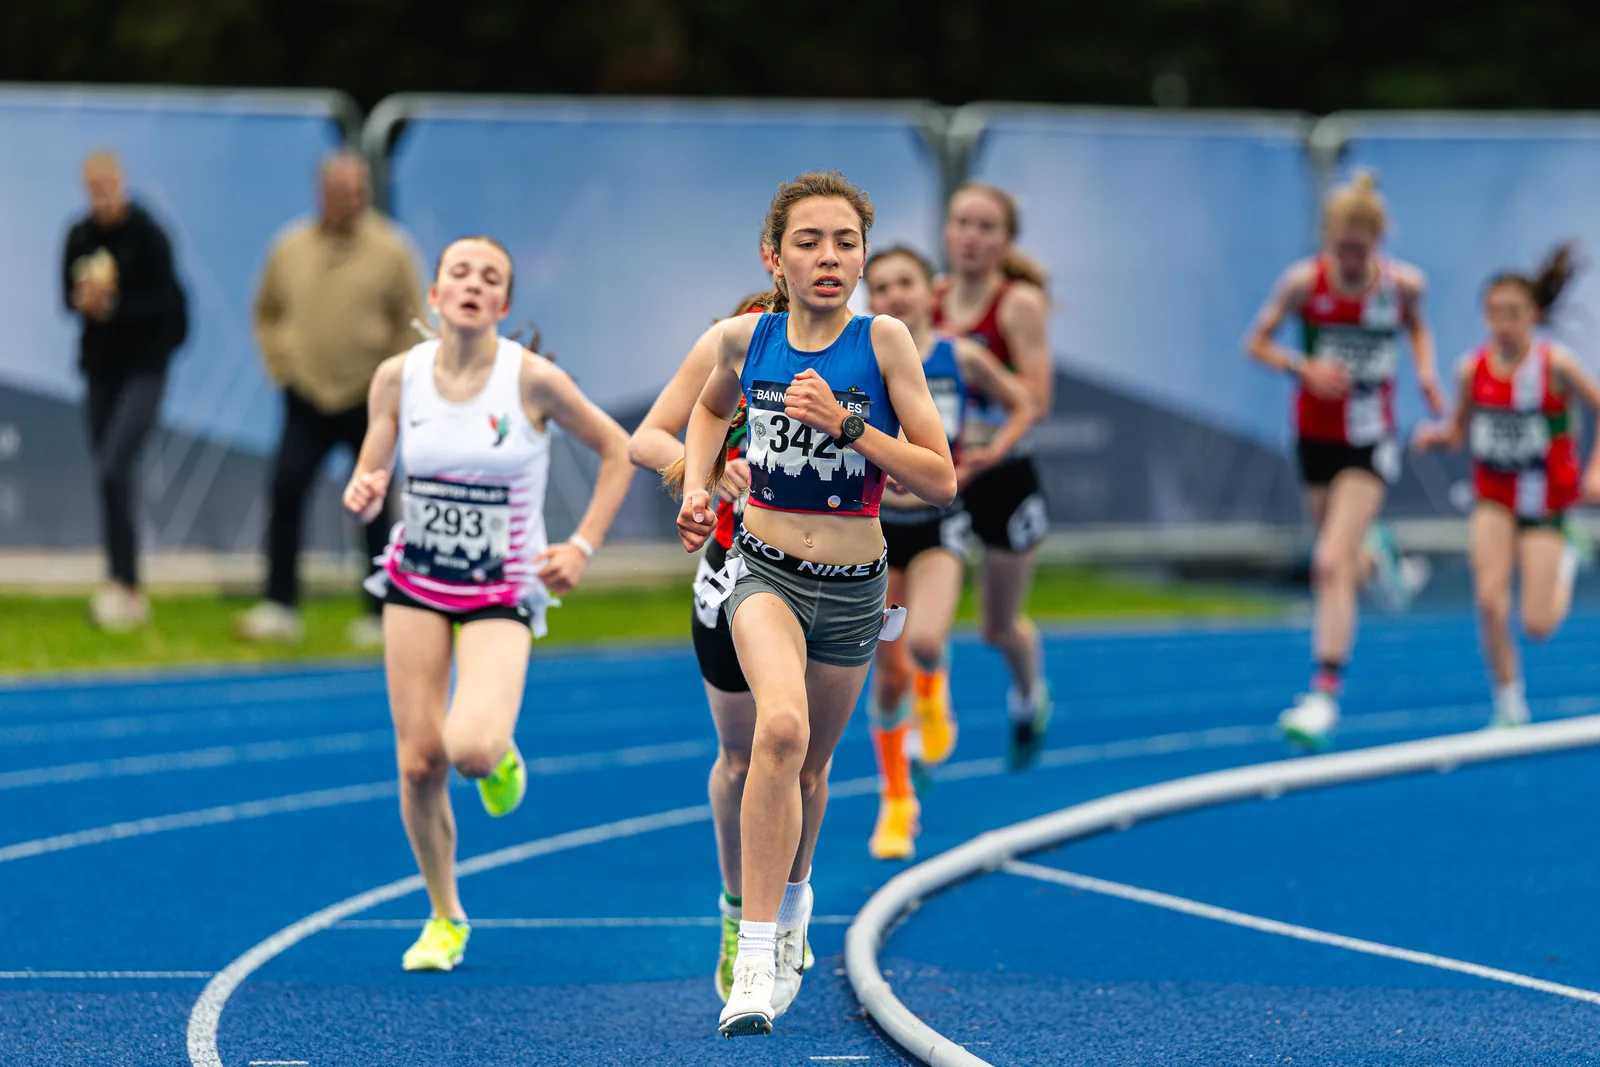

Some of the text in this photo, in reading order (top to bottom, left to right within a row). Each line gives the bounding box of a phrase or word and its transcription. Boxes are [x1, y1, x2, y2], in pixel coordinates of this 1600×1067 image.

[769, 414, 837, 460] 342
[424, 503, 483, 538] 293
[797, 560, 874, 577] NIKE
